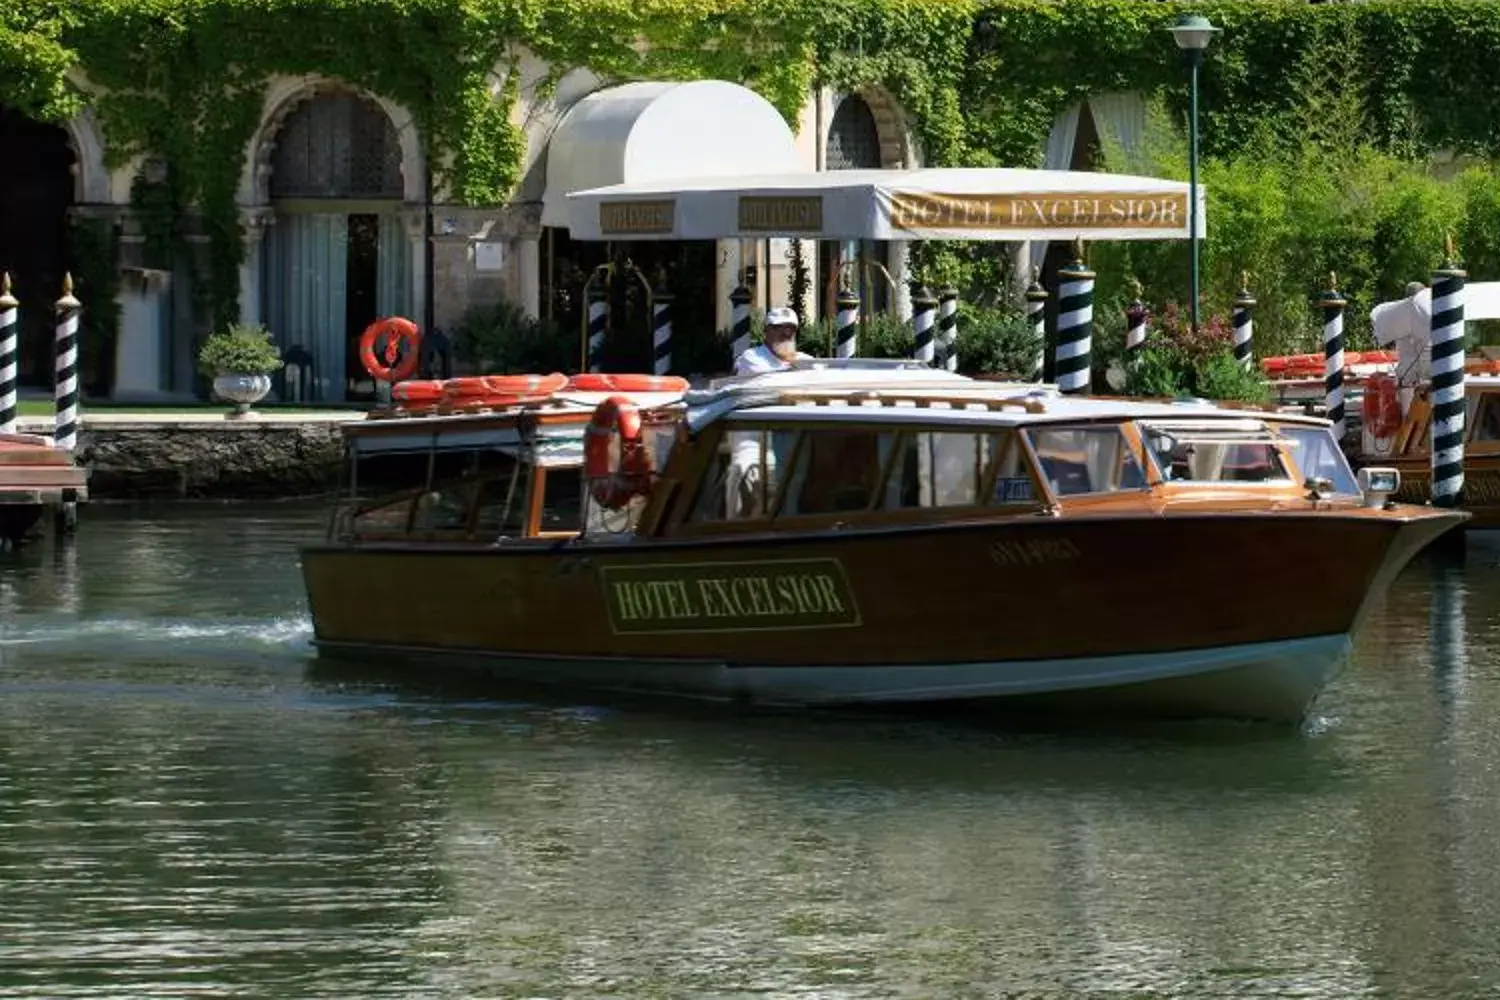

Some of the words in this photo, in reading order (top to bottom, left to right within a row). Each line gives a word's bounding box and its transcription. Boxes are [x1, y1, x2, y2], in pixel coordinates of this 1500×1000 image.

[898, 198, 1000, 226] HOTEL
[1009, 198, 1179, 227] EXCELSIOR
[613, 580, 699, 620] HOTEL
[697, 574, 845, 617] EXCELSIOR
